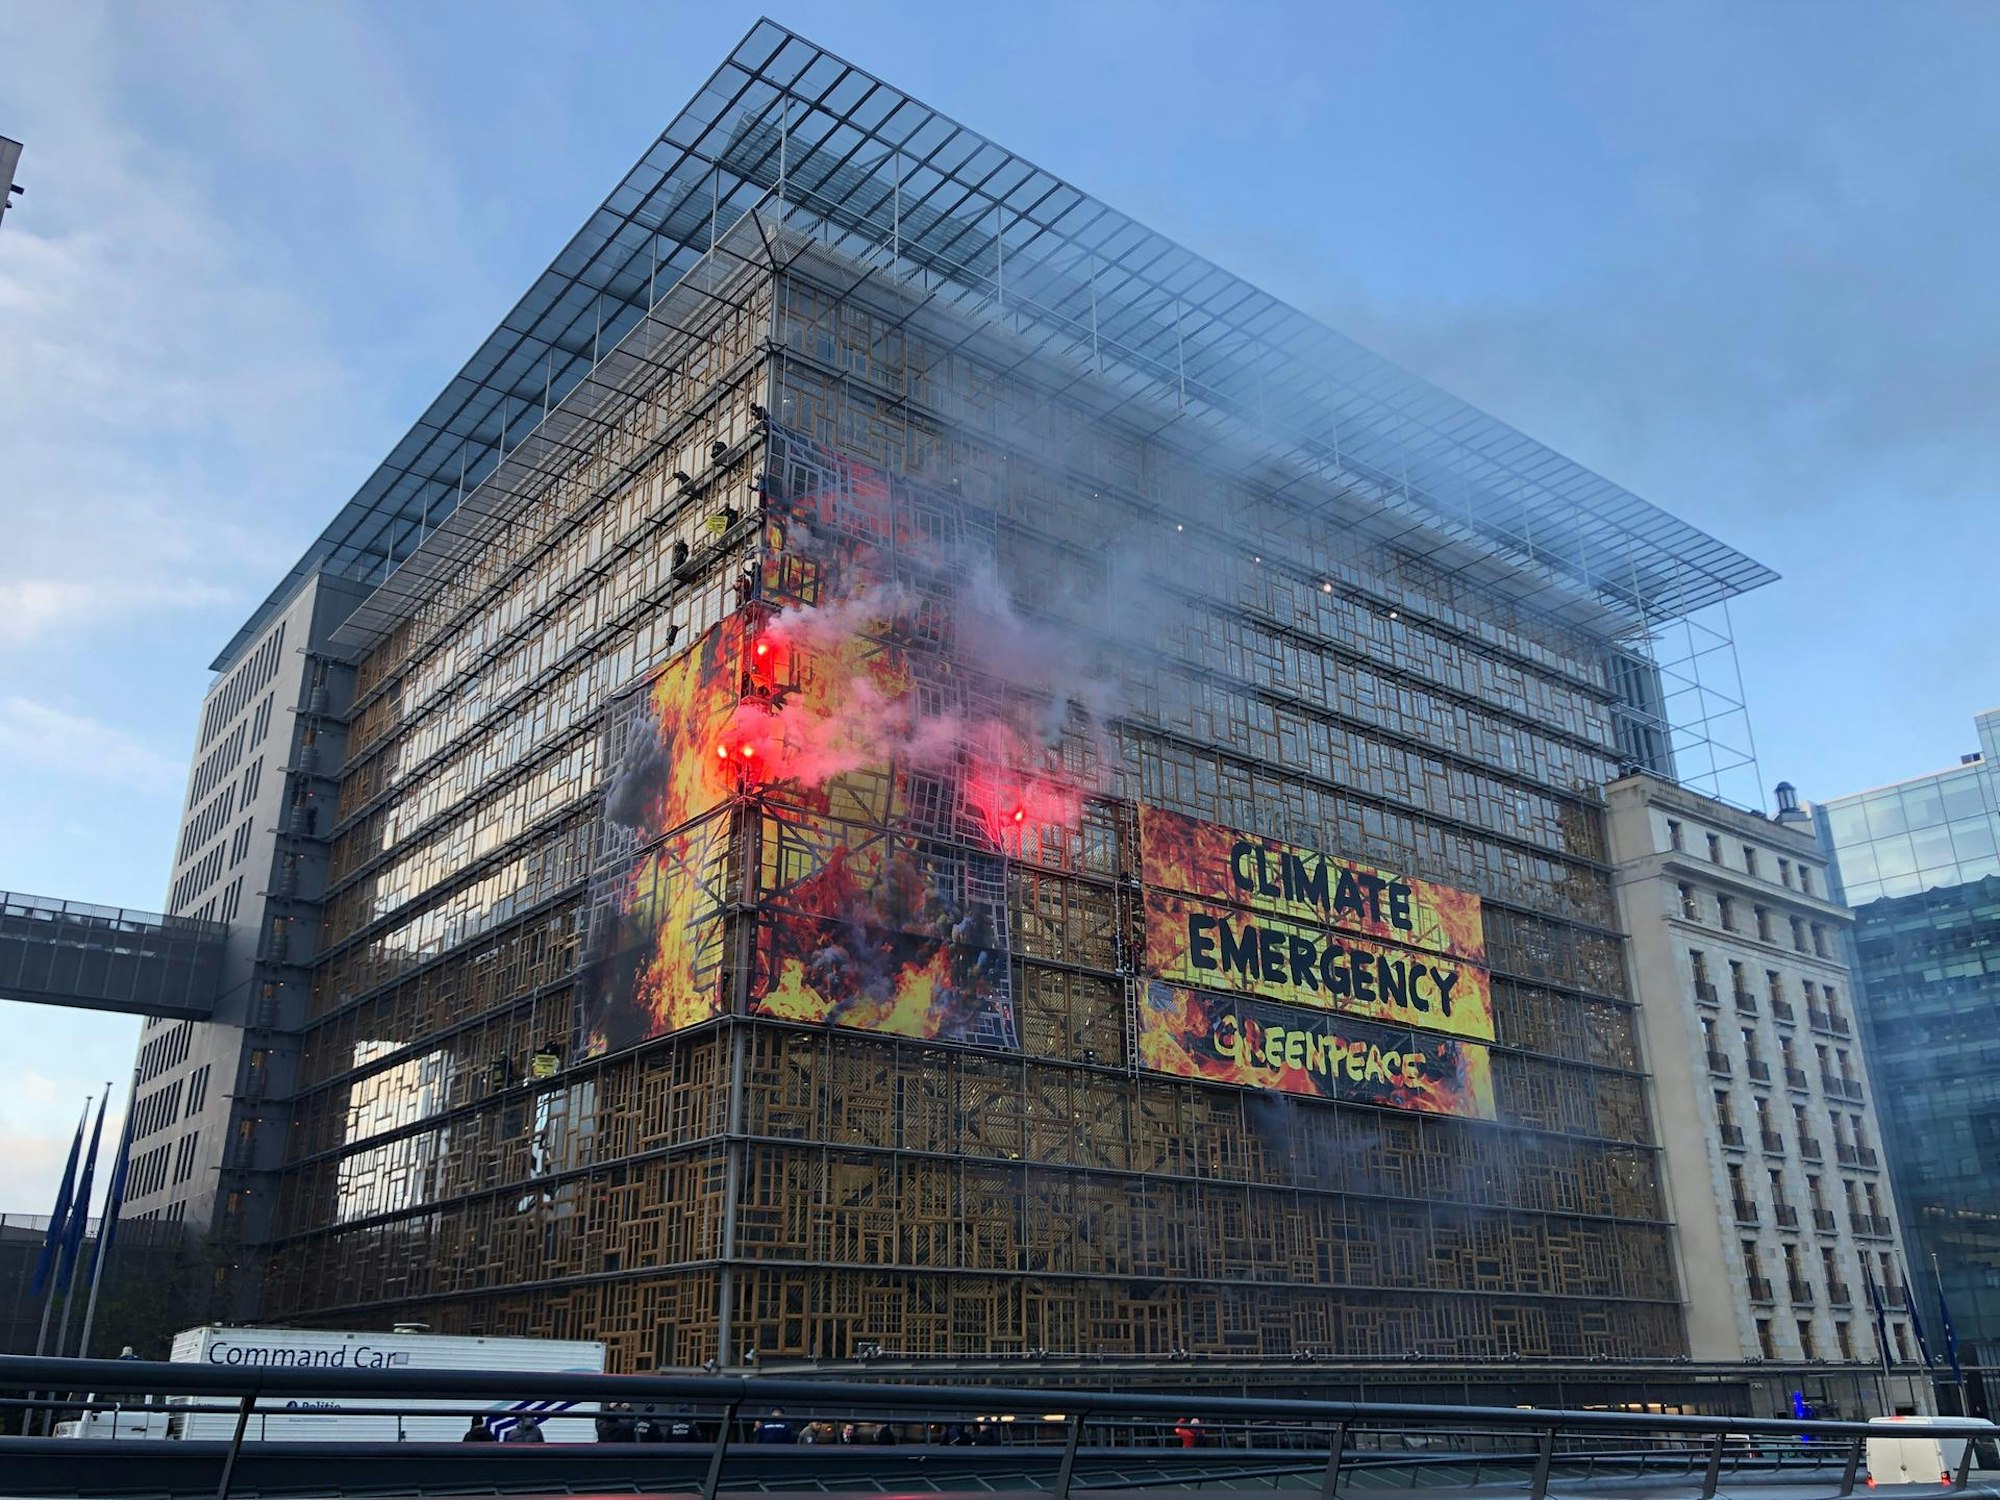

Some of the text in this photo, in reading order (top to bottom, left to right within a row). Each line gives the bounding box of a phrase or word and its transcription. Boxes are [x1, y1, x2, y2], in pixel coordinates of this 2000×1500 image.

[1231, 841, 1413, 931] CLIMATE
[1188, 913, 1459, 1017] EMERGENCY
[1214, 1014, 1426, 1089] GREENPEACE
[209, 1342, 396, 1369] Command Car
